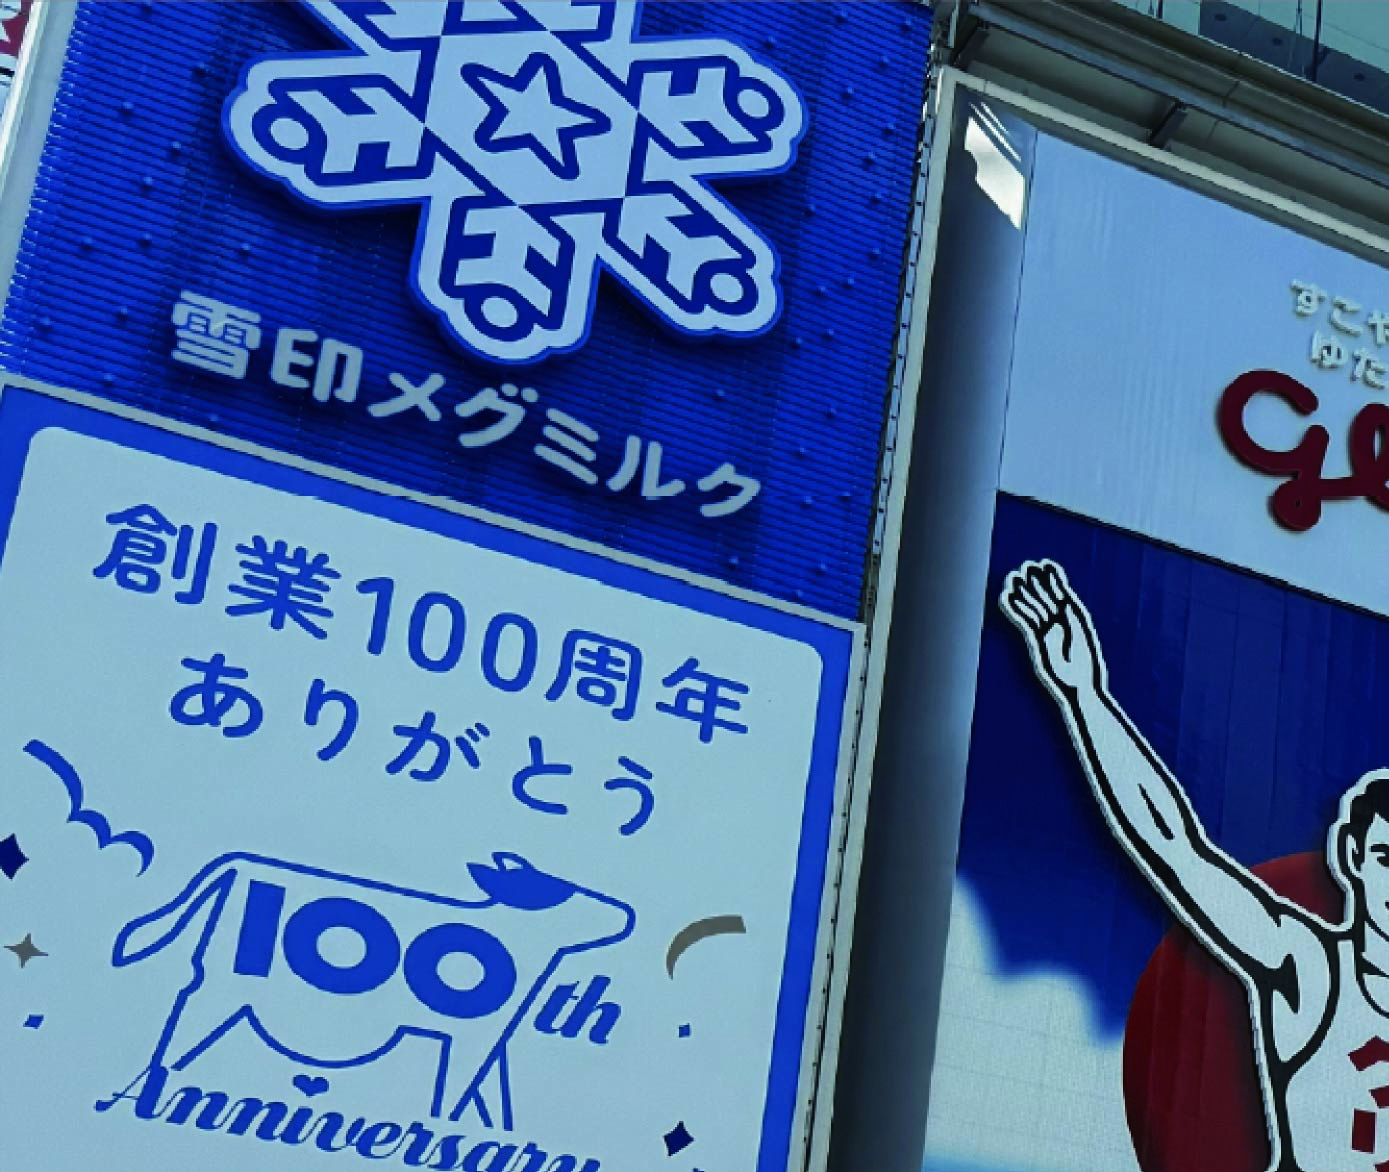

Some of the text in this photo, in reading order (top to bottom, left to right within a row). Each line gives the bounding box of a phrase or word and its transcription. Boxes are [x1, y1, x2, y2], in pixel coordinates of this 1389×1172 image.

[171, 290, 761, 517] 雪印メグミルク
[93, 504, 751, 744] 創業100周年
[169, 654, 655, 836] ありがとう
